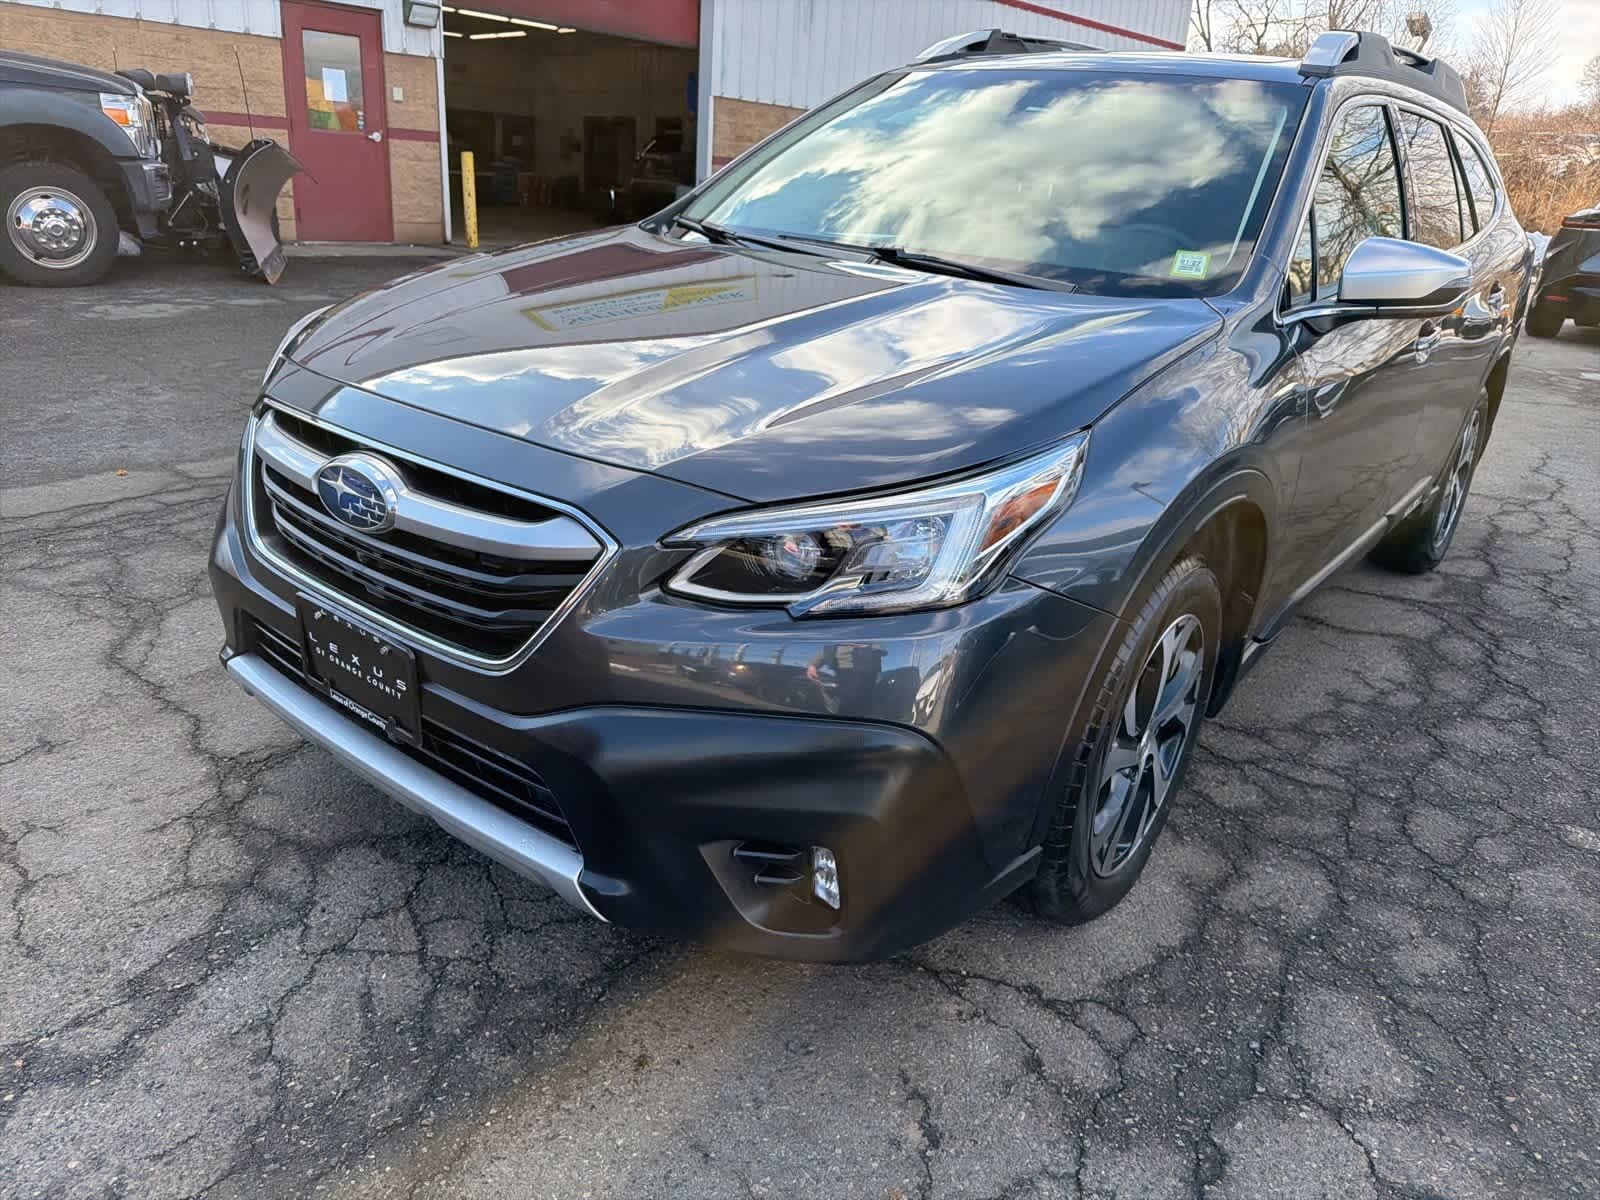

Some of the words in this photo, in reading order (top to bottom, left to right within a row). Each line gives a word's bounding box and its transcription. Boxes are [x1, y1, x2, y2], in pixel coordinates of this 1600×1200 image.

[308, 631, 407, 691] LEXUS
[329, 654, 362, 678] ORANGE
[366, 675, 402, 699] COUNTY
